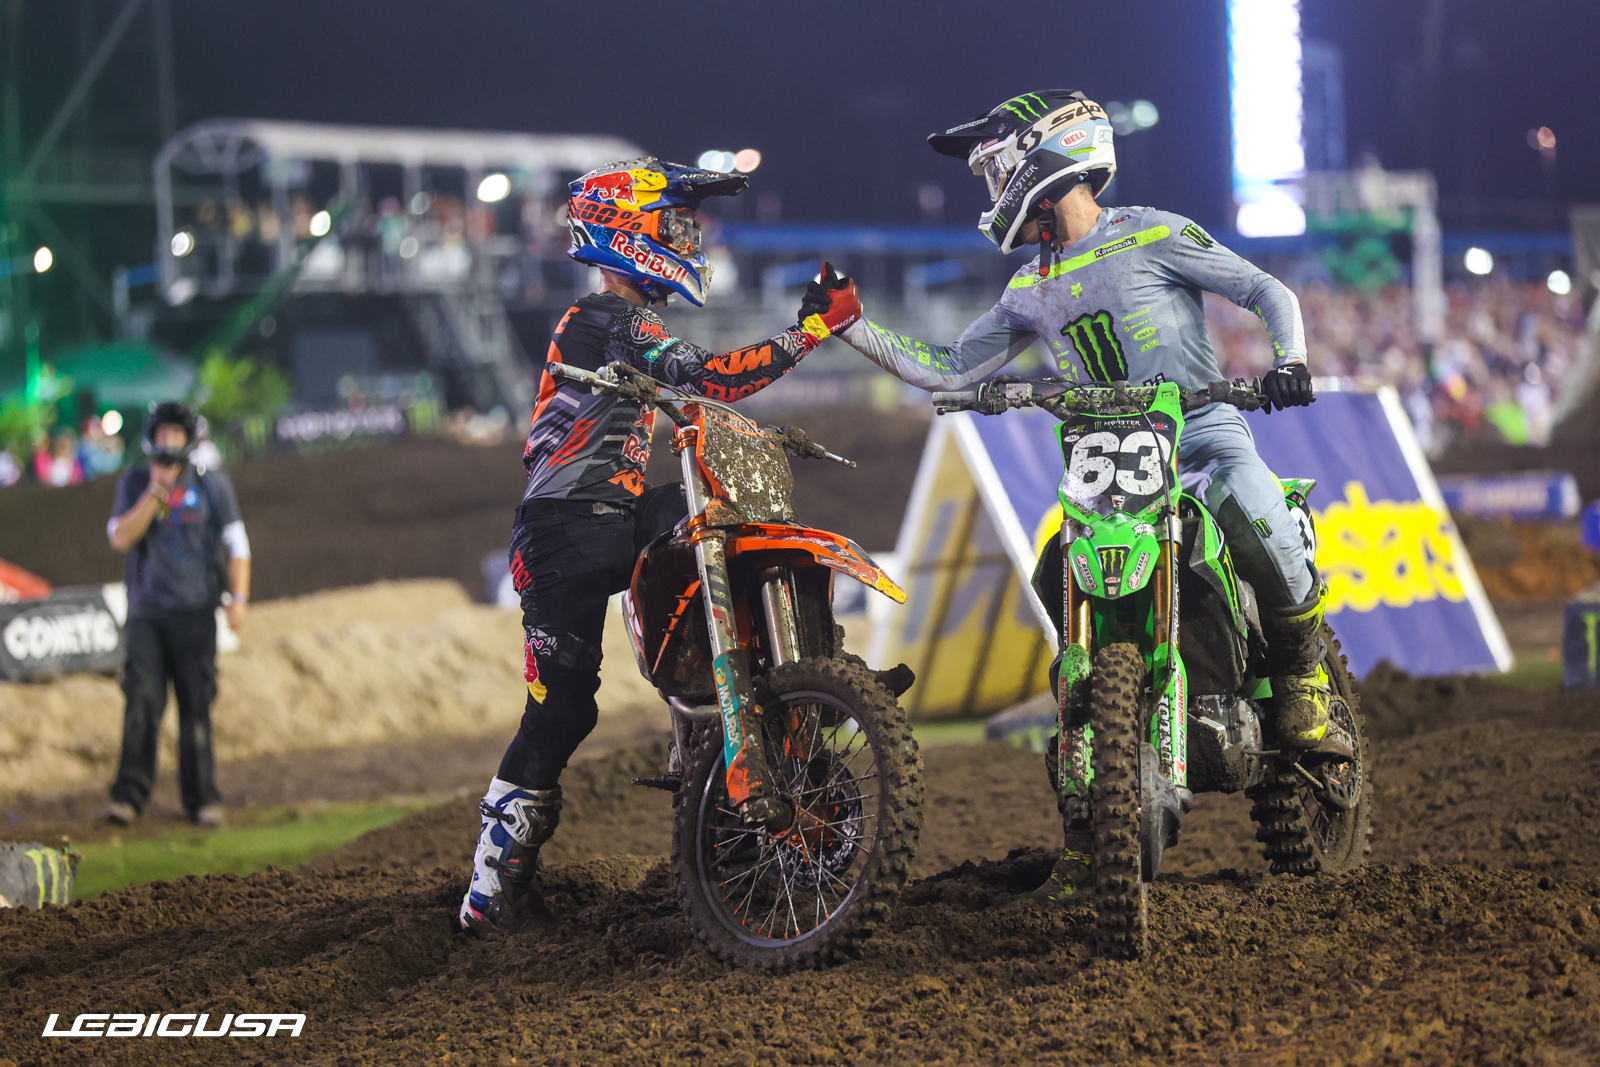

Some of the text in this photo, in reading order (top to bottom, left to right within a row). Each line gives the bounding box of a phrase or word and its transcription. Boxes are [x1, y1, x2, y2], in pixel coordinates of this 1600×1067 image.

[1063, 131, 1086, 145] BELL
[1000, 164, 1039, 209] MONSTER
[1011, 176, 1037, 208] ENERGY
[575, 200, 645, 231] 100%
[610, 232, 689, 284] Red Bull
[1095, 237, 1137, 258] Kawasaki
[703, 343, 773, 375] KTM
[1103, 419, 1141, 427] MONSTER
[1069, 430, 1172, 499] 63
[718, 685, 740, 746] MOTOREX
